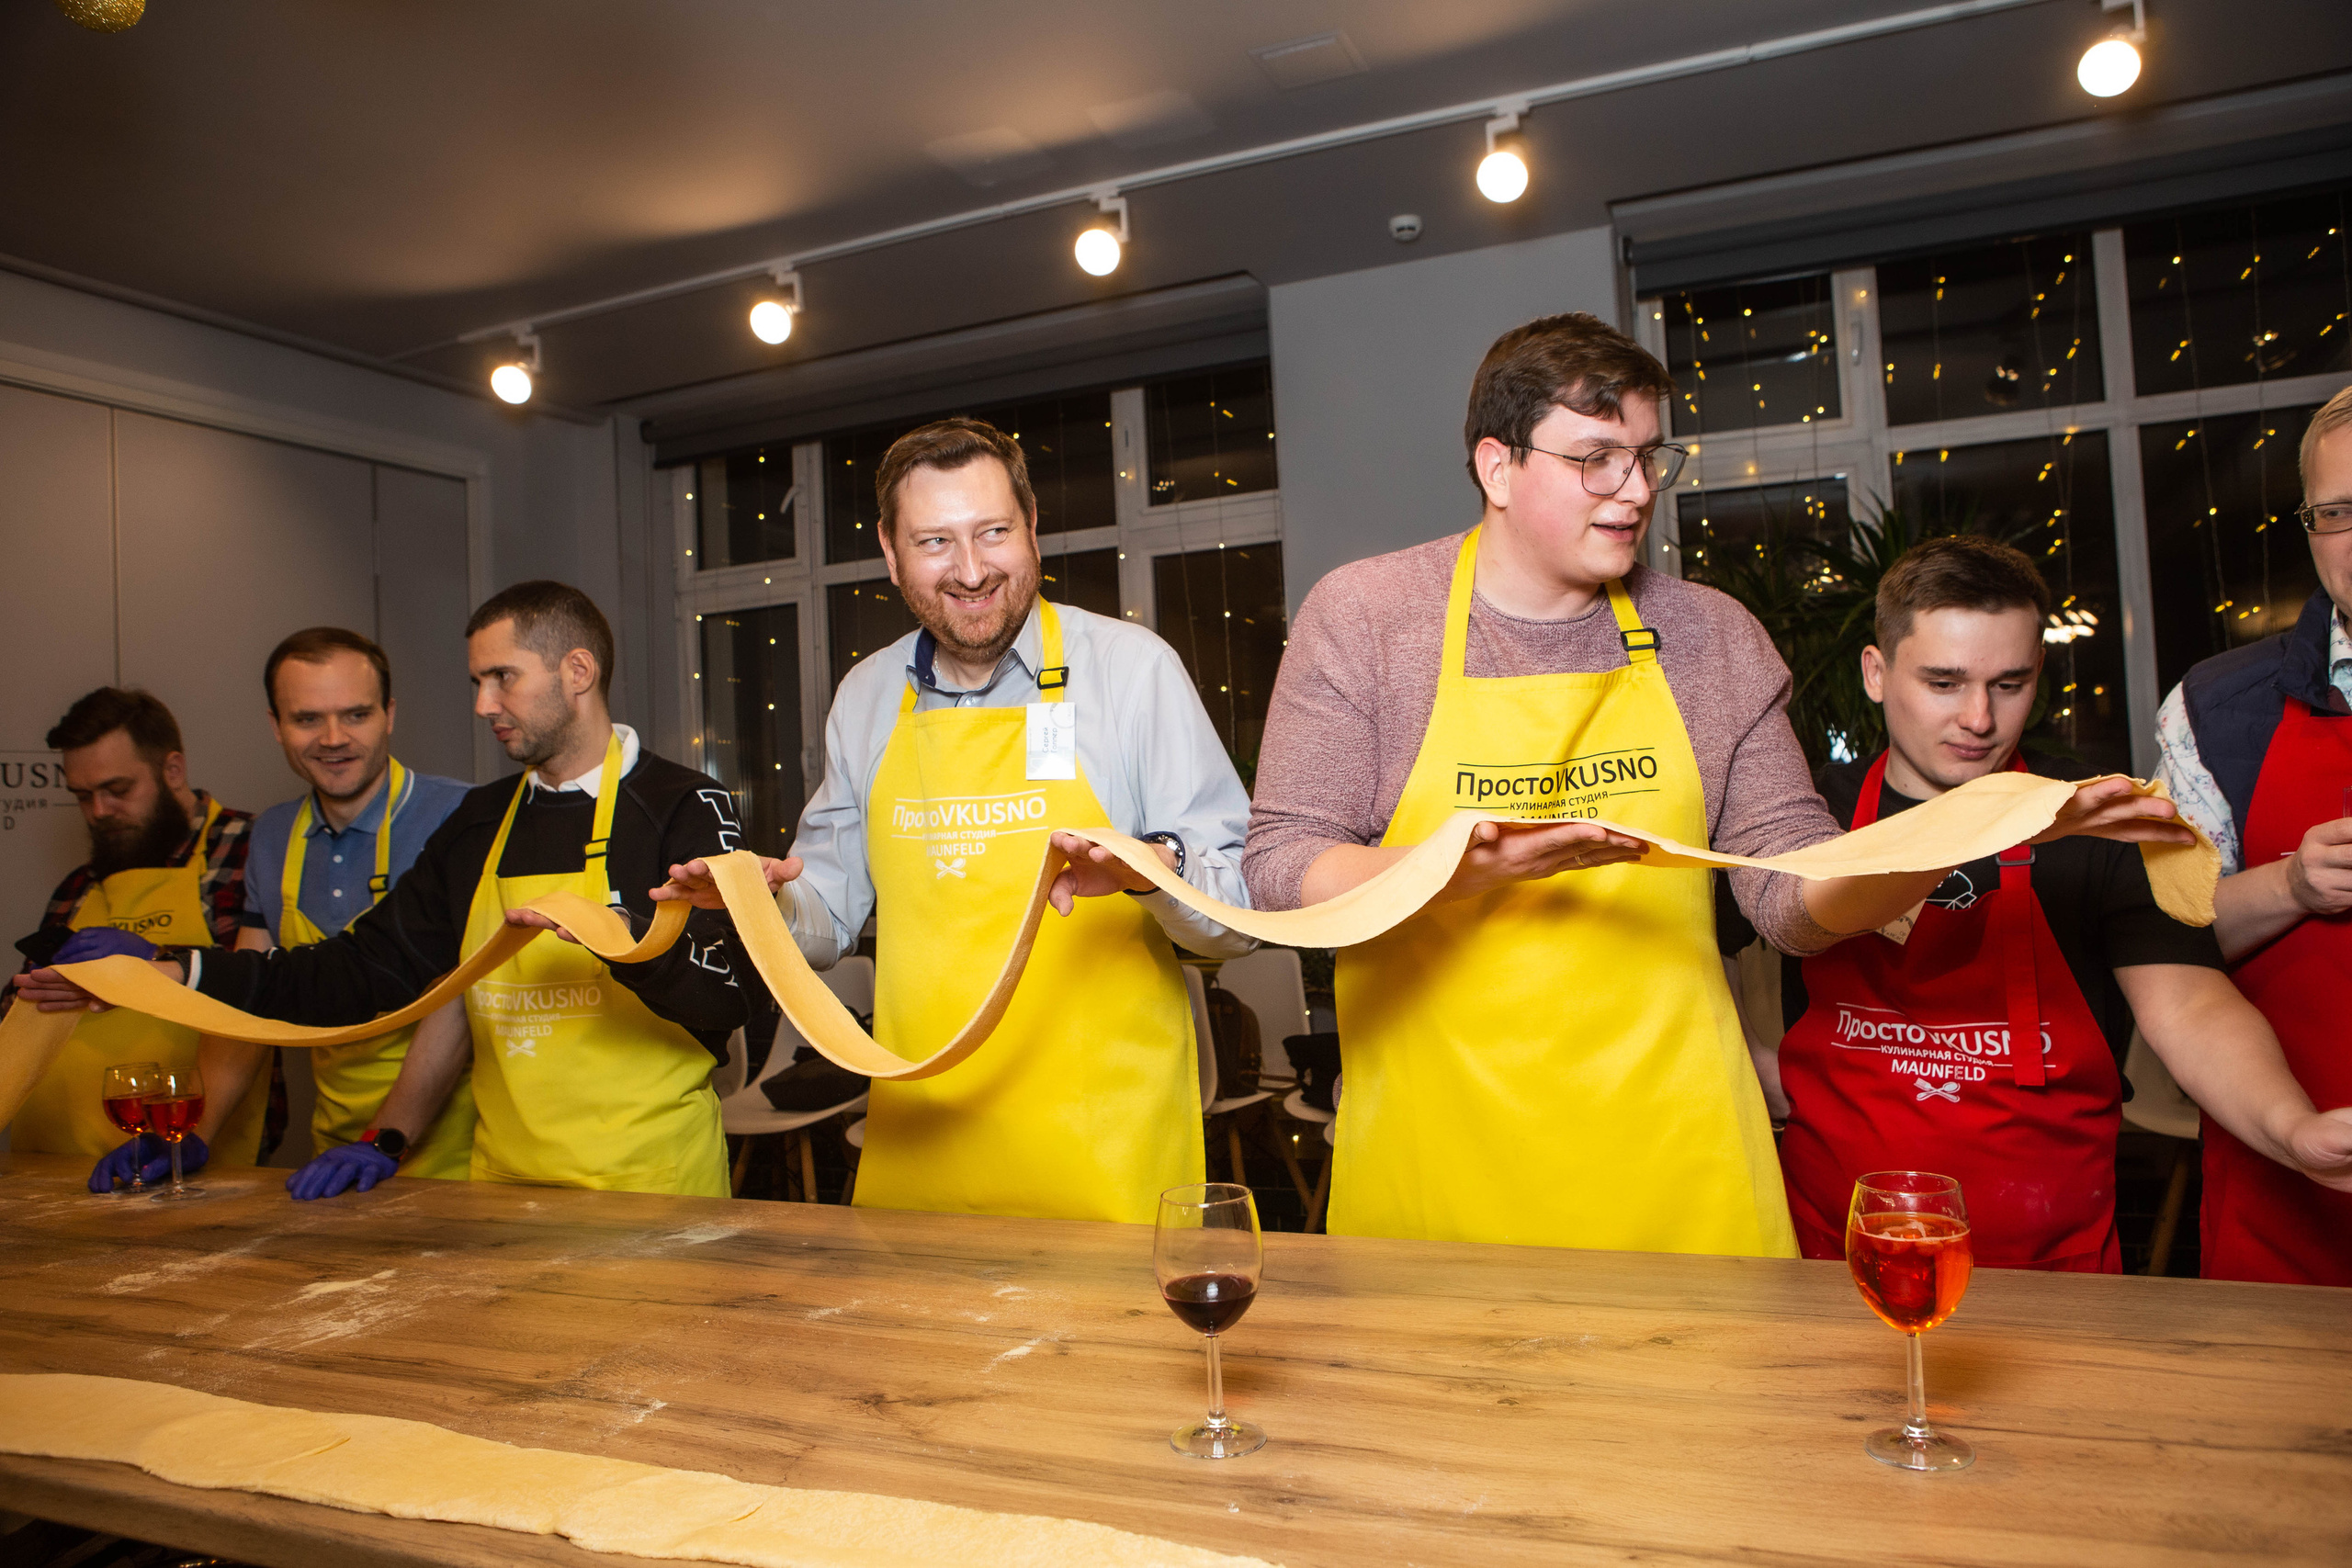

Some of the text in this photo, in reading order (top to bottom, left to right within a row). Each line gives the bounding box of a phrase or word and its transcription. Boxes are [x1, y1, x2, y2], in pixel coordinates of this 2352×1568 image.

[1456, 755, 1657, 801] ПростоVKUSNO
[1510, 791, 1609, 811] КУЛИНАРНАЯ СТУДИЯ
[1881, 1044, 1951, 1061] КУЛИНАРНАЯ
[1891, 1059, 1986, 1082] MAUNFELD
